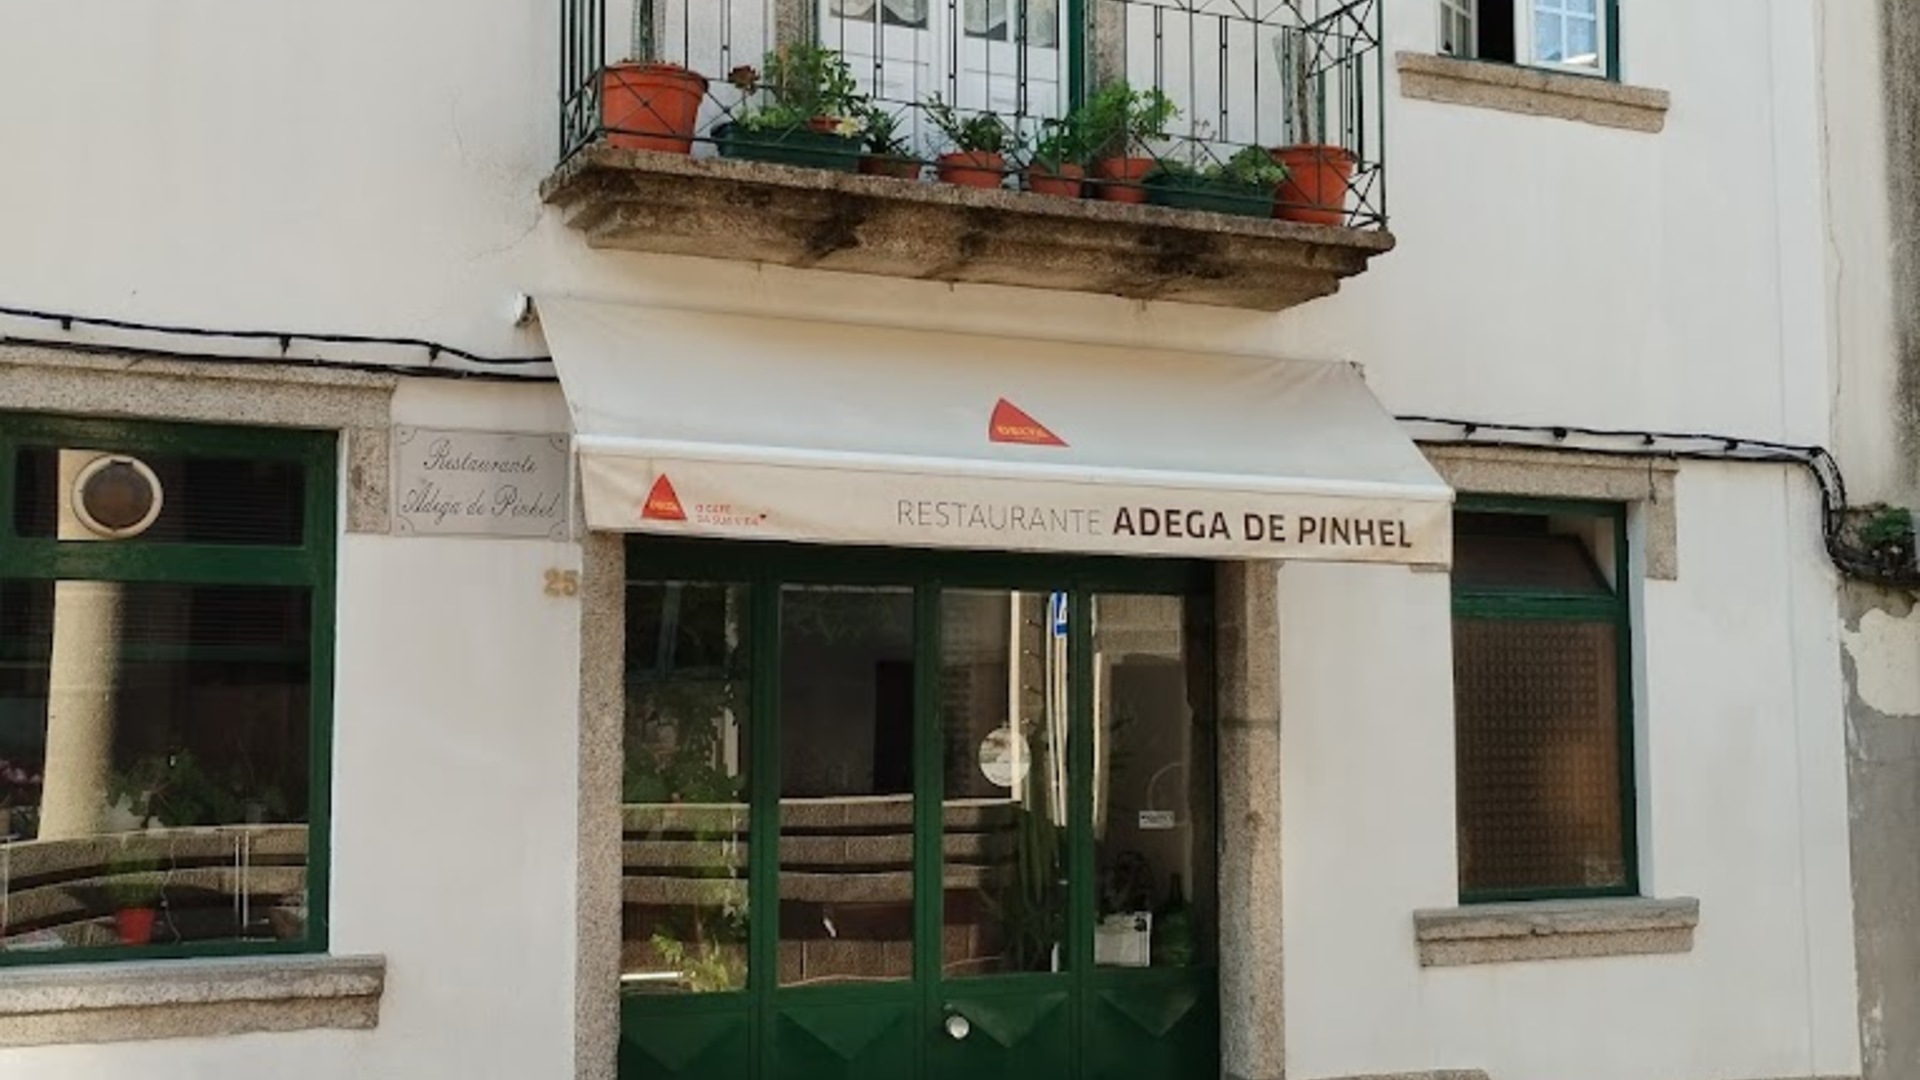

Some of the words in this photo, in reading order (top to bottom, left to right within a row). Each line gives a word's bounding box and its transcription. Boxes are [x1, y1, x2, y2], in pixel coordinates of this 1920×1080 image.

[424, 438, 537, 472] Restaurante
[402, 481, 461, 525] Adega
[466, 489, 485, 516] de
[491, 484, 561, 518] Pinhel
[897, 499, 1102, 535] RESTAURANTE
[1112, 506, 1231, 541] ADEGA
[1243, 512, 1286, 543] DE
[1296, 515, 1413, 549] PINHEL
[543, 568, 578, 597] 25
